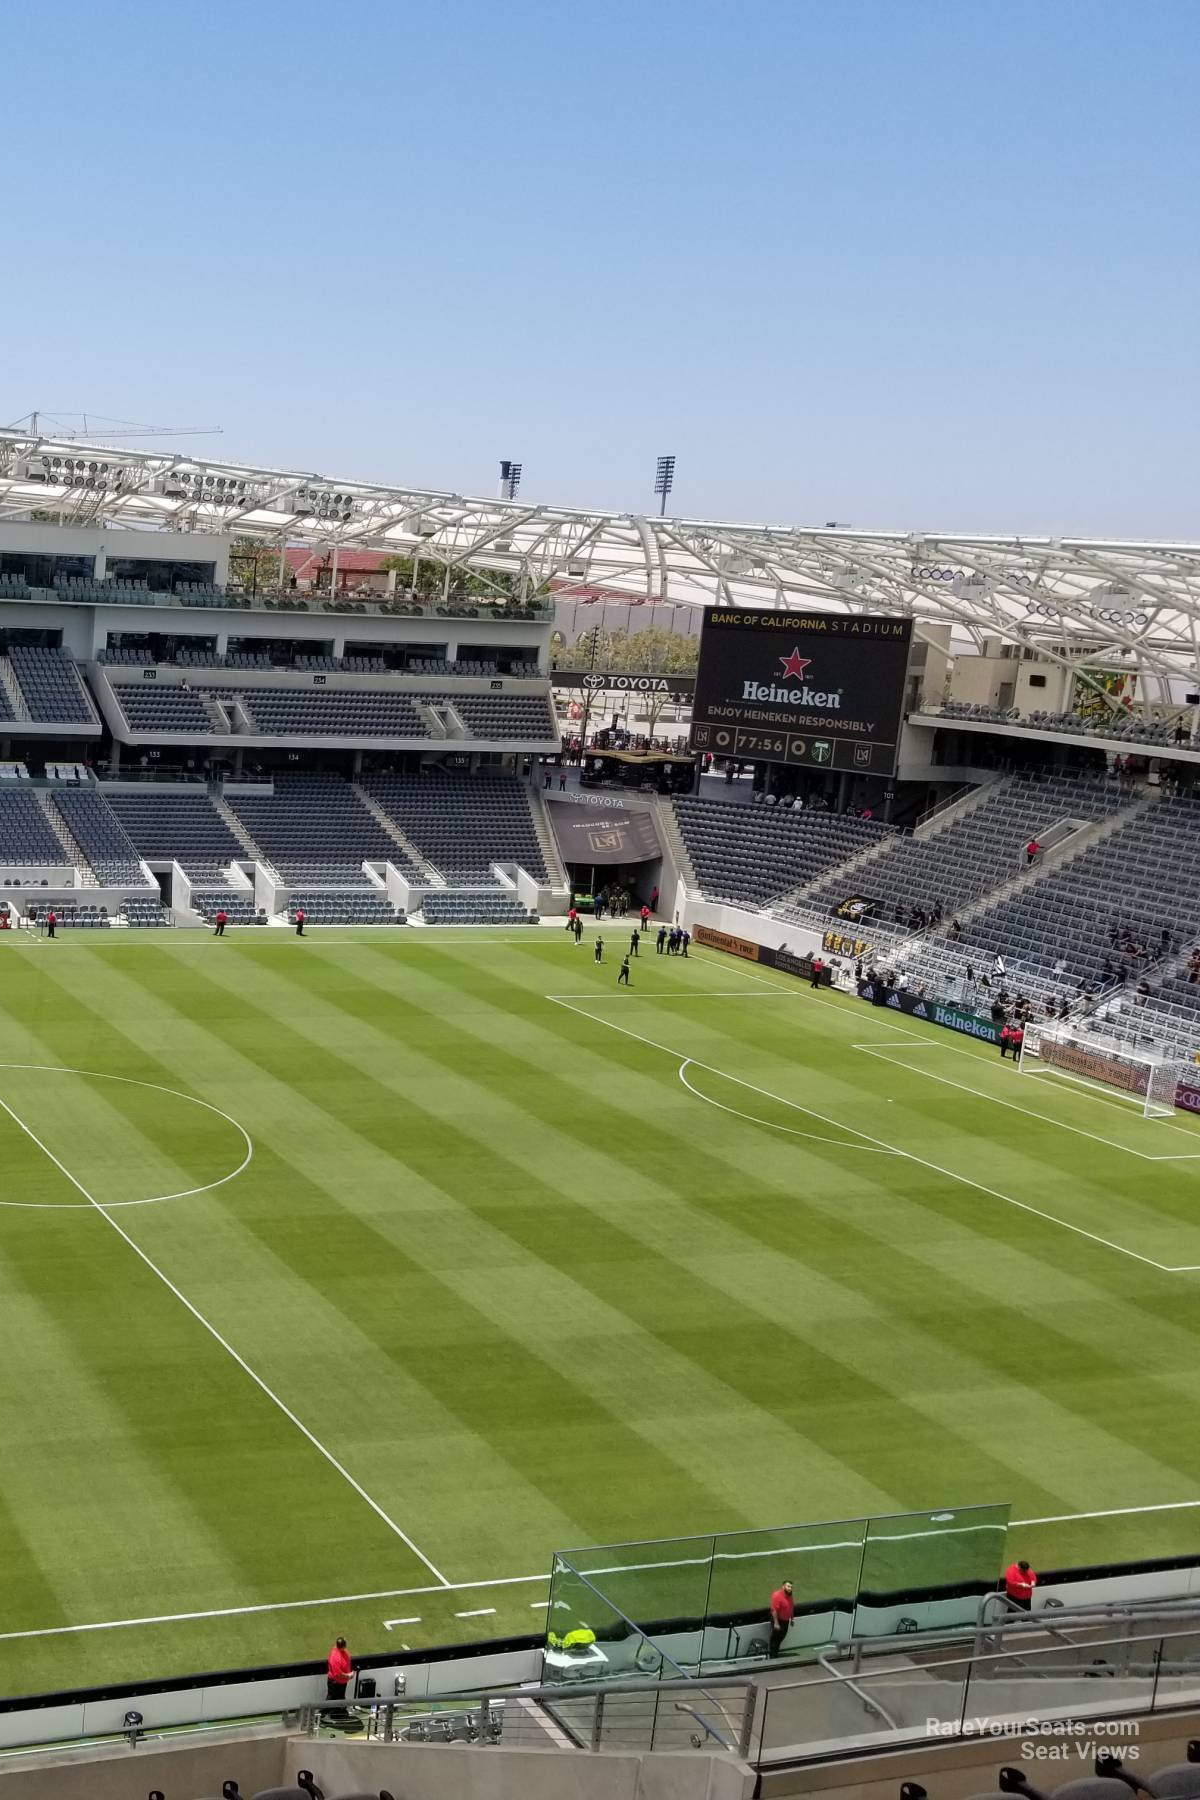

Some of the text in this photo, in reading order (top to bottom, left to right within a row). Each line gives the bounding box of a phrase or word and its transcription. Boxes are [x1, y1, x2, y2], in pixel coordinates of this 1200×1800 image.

[711, 613, 903, 636] BANC OF CALIFORNIA STADIUM
[608, 676, 669, 691] TOYOTA
[742, 681, 841, 709] Heineken
[707, 705, 875, 732] ENJOY HEINEKEN RESPONSIBLY
[737, 735, 783, 752] 77:56
[585, 795, 624, 808] TOYOTA
[697, 928, 733, 948] Continental
[775, 952, 812, 970] LOS ANGELES
[775, 961, 811, 977] FOOTBALL CLUB
[934, 1007, 996, 1041] Heineken
